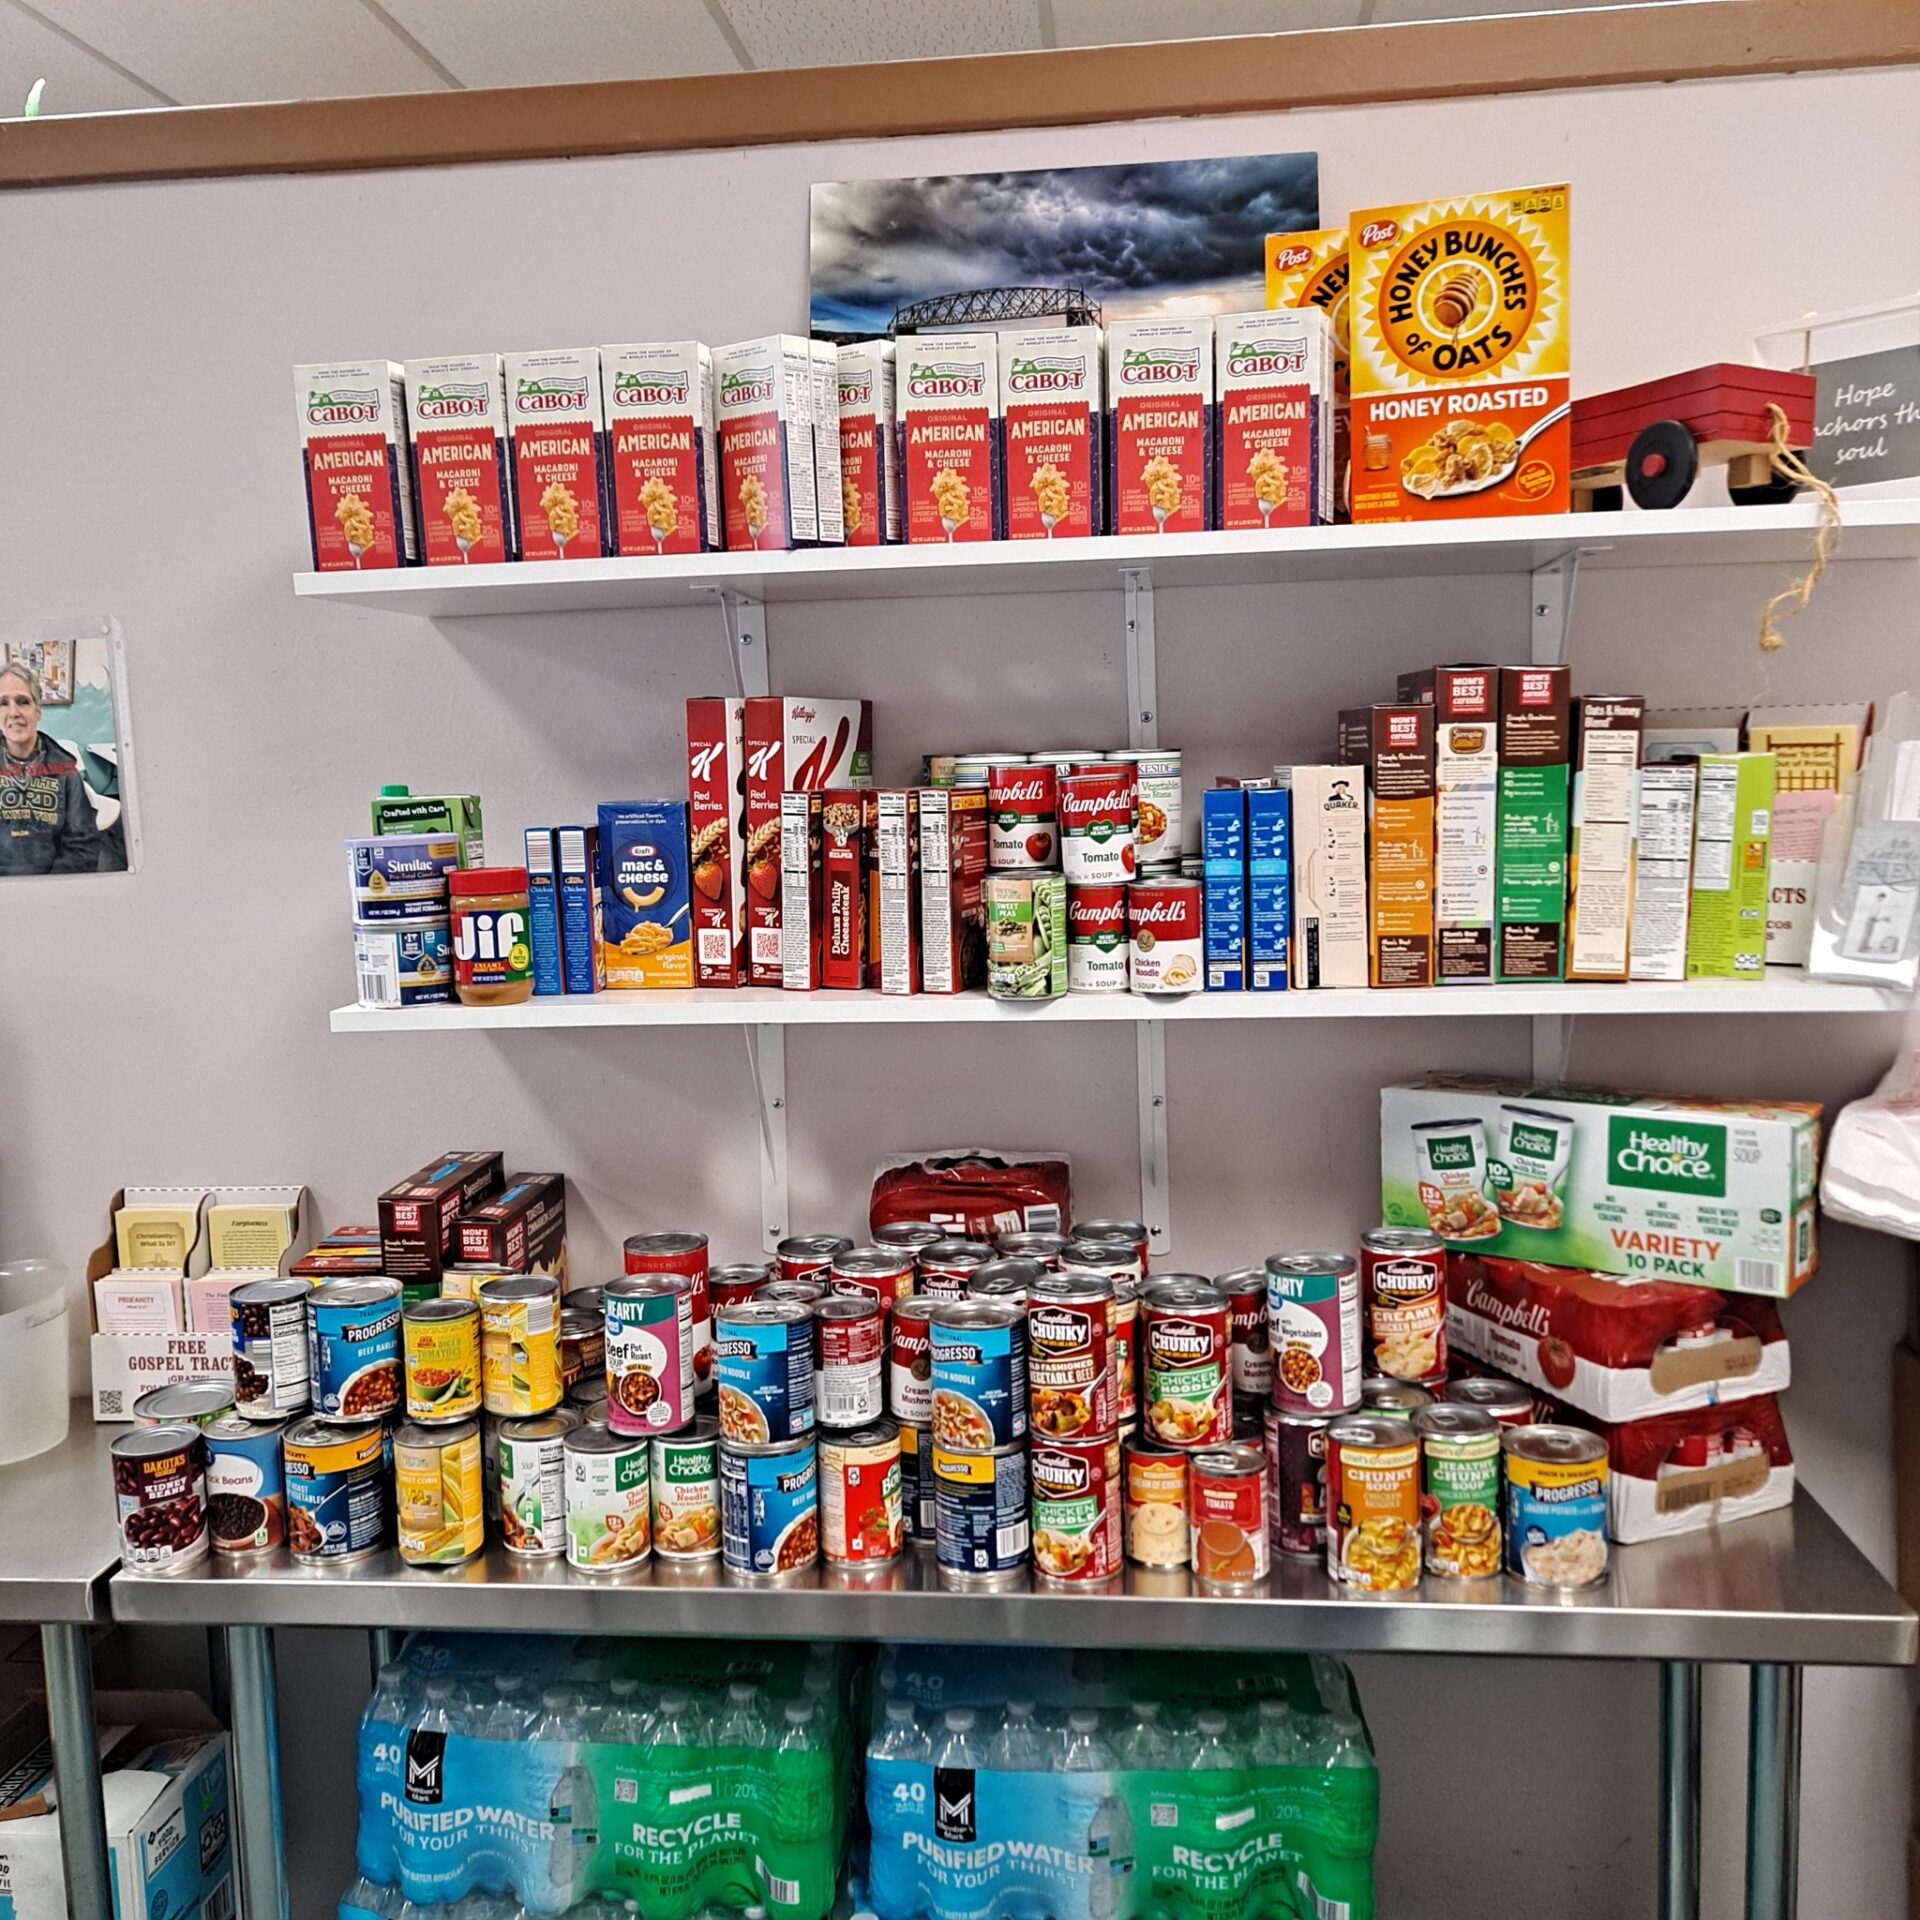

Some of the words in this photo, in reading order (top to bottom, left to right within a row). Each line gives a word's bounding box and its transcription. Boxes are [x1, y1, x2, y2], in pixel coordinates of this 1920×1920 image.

[1363, 224, 1396, 242] Post
[1278, 249, 1310, 265] Post
[1389, 239, 1438, 324] HONEY
[1445, 231, 1527, 311] BUNCHES
[1310, 263, 1349, 308] NEY
[1406, 333, 1431, 355] of
[1433, 323, 1512, 370] OATS
[1123, 364, 1198, 382] CABOT
[910, 376, 983, 394] CABOT
[1835, 383, 1896, 407] Hope
[1370, 399, 1445, 421] HONEY
[1448, 387, 1548, 412] ROASTED
[309, 404, 378, 422] CABOT
[1122, 411, 1198, 431] AMERICAN
[1813, 414, 1888, 436] nchors
[910, 424, 984, 444] AMERICAN
[1137, 436, 1184, 446] MACARONI
[925, 449, 971, 458] MACARONI
[1139, 447, 1145, 456] &
[1149, 447, 1182, 455] CHEESE
[1834, 436, 1888, 465] soul
[313, 450, 383, 470] AMERICAN
[927, 459, 933, 468] &
[937, 458, 970, 467] CHEESE
[1452, 676, 1484, 686] MOM'S
[1452, 686, 1483, 696] BEST
[1453, 695, 1484, 705] cereals
[791, 706, 816, 723] Kellogg's
[1390, 716, 1417, 724] MOM'S
[1390, 724, 1416, 733] BEST
[1585, 717, 1613, 728] Blend
[792, 736, 816, 744] SPECIAL
[1390, 732, 1417, 740] cereals
[1138, 764, 1172, 772] KESIDE
[694, 791, 709, 800] Red
[989, 781, 1044, 804] ampbell's
[694, 801, 723, 811] Berries
[1063, 790, 1130, 816] Campbell's
[1324, 802, 1359, 811] QUAKER
[33, 810, 58, 824] YOU
[383, 807, 410, 817] Crafted
[412, 807, 427, 815] with
[429, 805, 444, 813] Care
[993, 840, 1023, 849] Tomato
[1083, 852, 1119, 863] Tomato
[388, 859, 433, 873] Similac
[622, 860, 653, 872] mac
[653, 860, 664, 872] &
[618, 872, 668, 883] cheese
[832, 881, 842, 916] Philly
[997, 902, 1018, 910] SWEET
[841, 886, 850, 955] Cheesesteak
[454, 912, 524, 960] Jif
[832, 920, 841, 954] Deluxe
[656, 954, 687, 962] original
[1135, 958, 1160, 967] Chicken
[663, 961, 687, 970] flavor
[1087, 960, 1123, 971] Tomato
[1136, 968, 1159, 977] Noodle
[1518, 1129, 1551, 1143] Healthy
[1435, 1142, 1468, 1155] Healthy
[1512, 1138, 1552, 1154] Choice
[1630, 1129, 1709, 1158] Healthy
[1432, 1151, 1471, 1163] Choice
[1733, 1150, 1761, 1163] SOUP
[1515, 1157, 1547, 1170] Chicken
[1617, 1150, 1712, 1179] Choice
[1441, 1171, 1470, 1179] Chicken
[1513, 1164, 1529, 1173] with
[1530, 1167, 1547, 1177] Rice
[1593, 1203, 1627, 1215] ARTIFICIAL
[1645, 1210, 1680, 1221] ARTIFICIAL
[1698, 1206, 1718, 1216] MADE
[1720, 1208, 1738, 1218] WITH
[1598, 1213, 1624, 1223] COLORS
[1648, 1219, 1678, 1229] FLAVORS
[462, 1229, 488, 1237] MOM'S
[1703, 1227, 1733, 1237] CHICKEN
[463, 1236, 488, 1245] BEST
[1610, 1228, 1722, 1261] VARIETY
[463, 1244, 488, 1252] cereals
[1626, 1253, 1646, 1270] 10
[1654, 1255, 1706, 1279] PACK
[1376, 1272, 1434, 1292] CHUNKY
[607, 1300, 644, 1320] HEARTY
[1466, 1277, 1551, 1335] Campbell's
[1373, 1306, 1437, 1323] CREAMY
[348, 1312, 400, 1342] PROGRESSO
[1030, 1318, 1085, 1342] CHUNKY
[1281, 1329, 1323, 1338] Vegetables
[168, 1340, 206, 1354] FREE
[358, 1346, 375, 1357] BEEF
[376, 1340, 398, 1354] BARLEY
[607, 1337, 629, 1358] Beef
[631, 1344, 642, 1352] Pot
[1152, 1333, 1209, 1356] CHUNKY
[630, 1351, 652, 1360] Roast
[129, 1357, 184, 1371] GOSPEL
[190, 1356, 236, 1370] TRACT
[728, 1369, 751, 1380] NOODLE
[1030, 1370, 1075, 1385] VEGETABLE
[1076, 1366, 1094, 1380] BEEF
[1160, 1371, 1216, 1386] CHICKEN
[1160, 1379, 1218, 1393] NOODLE
[143, 1454, 186, 1473] DAKOTA'S
[673, 1454, 710, 1469] Healthy
[1438, 1460, 1495, 1472] HEALTHY
[669, 1465, 713, 1476] Choice
[938, 1463, 969, 1474] PROGRESSO
[1032, 1466, 1084, 1486] CHUNKY
[1347, 1469, 1413, 1482] CHUNKY
[1434, 1469, 1496, 1483] CHUNKY
[145, 1478, 187, 1493] KIDNEY
[674, 1485, 709, 1494] Chicken
[1365, 1481, 1399, 1491] SOUP
[1451, 1480, 1486, 1491] SOUP
[1535, 1480, 1600, 1501] PROGRESSO
[149, 1486, 186, 1499] BEANS
[676, 1492, 708, 1501] Noodle
[1039, 1505, 1094, 1517] CHICKEN
[1205, 1499, 1235, 1511] TOMATO
[1039, 1513, 1095, 1525] NOODLE
[372, 1742, 401, 1764] 40
[892, 1782, 927, 1802] 40
[380, 1791, 473, 1833] PURIFIED
[475, 1806, 556, 1842] WATER
[632, 1812, 742, 1848] RECYCLE
[391, 1817, 416, 1849] FOR
[417, 1829, 468, 1852] YOUR
[474, 1824, 539, 1857] THIRST
[614, 1842, 648, 1866] FOR
[649, 1848, 682, 1866] THE
[687, 1830, 760, 1862] PLANET
[902, 1831, 1005, 1874] PURIFIED
[1007, 1840, 1096, 1875] WATER
